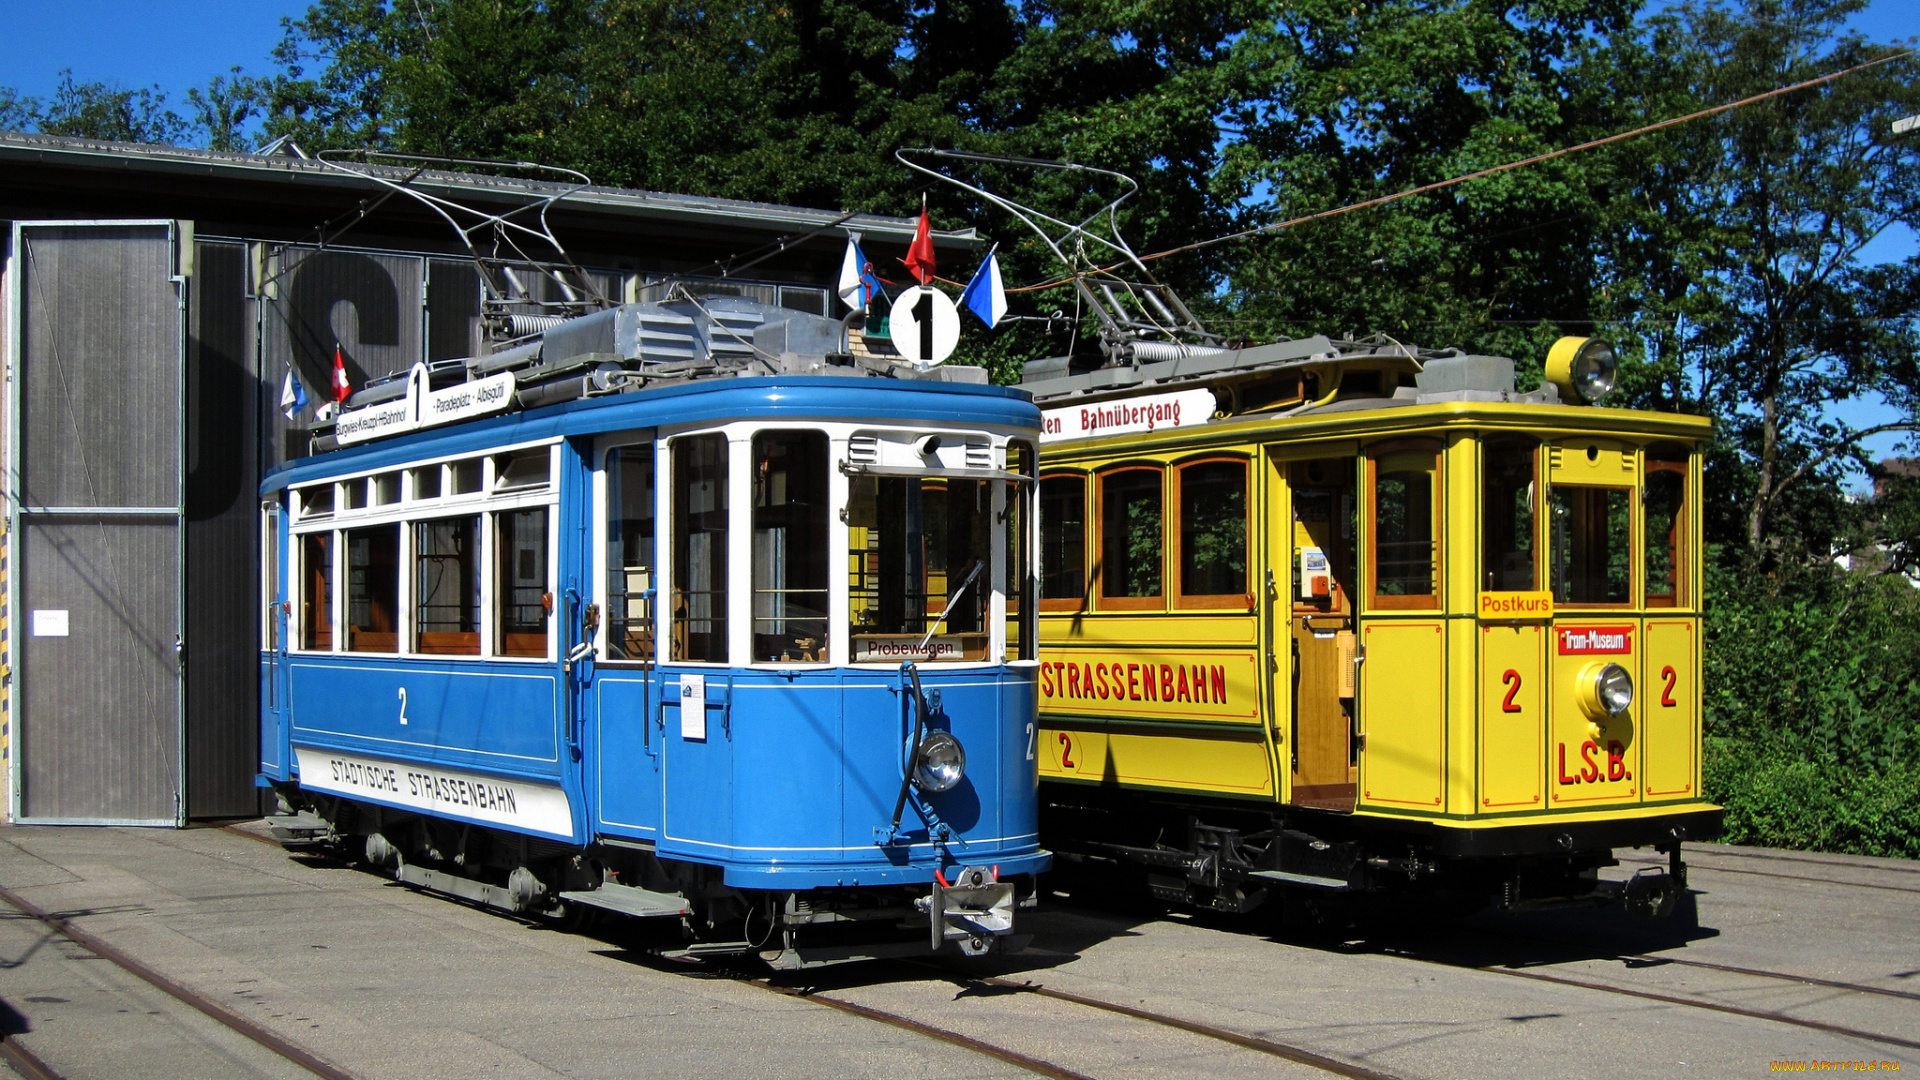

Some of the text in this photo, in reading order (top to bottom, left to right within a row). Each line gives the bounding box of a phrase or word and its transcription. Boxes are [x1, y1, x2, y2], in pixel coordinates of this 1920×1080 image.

[910, 293, 934, 361] 1
[413, 370, 420, 422] 1
[1080, 399, 1181, 431] Bahnübergang
[1482, 596, 1549, 612] Postkurs
[867, 641, 954, 659] Probewagen
[1565, 630, 1624, 649] Tram-Museum
[1041, 662, 1226, 704] STRASSENBAHN
[1502, 668, 1522, 713] 2
[1661, 665, 1676, 706] 2
[398, 687, 408, 725] 2
[1026, 723, 1034, 761] 2
[1059, 732, 1074, 768] 2
[1558, 740, 1632, 785] L.S.B.
[330, 758, 518, 815] STÄDTISCHE STRASSENBAHN
